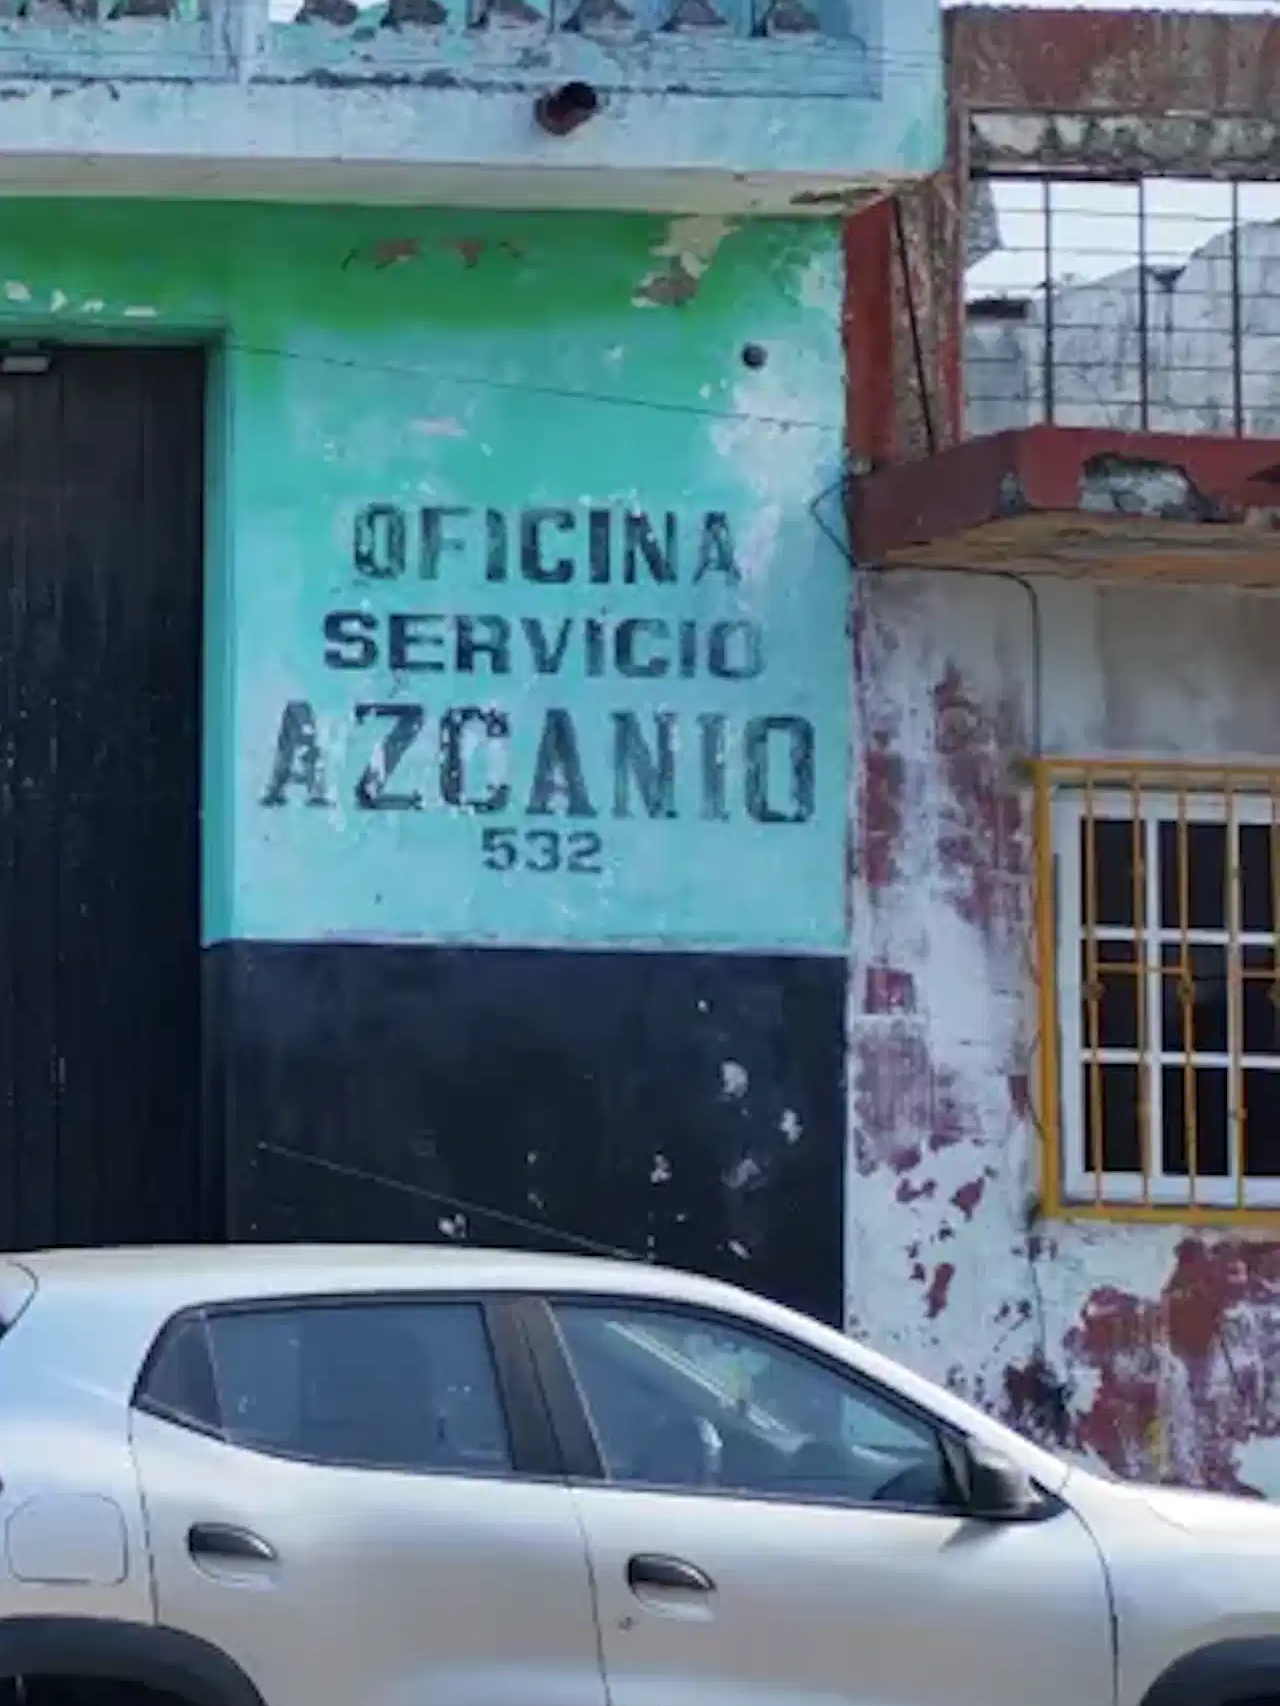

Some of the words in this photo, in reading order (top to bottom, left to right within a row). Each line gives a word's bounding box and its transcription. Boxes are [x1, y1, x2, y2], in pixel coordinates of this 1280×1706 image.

[352, 501, 742, 586] OFICINA
[323, 609, 767, 680] SERVICIO
[259, 699, 816, 824] AZCANIO
[481, 826, 604, 875] 532
